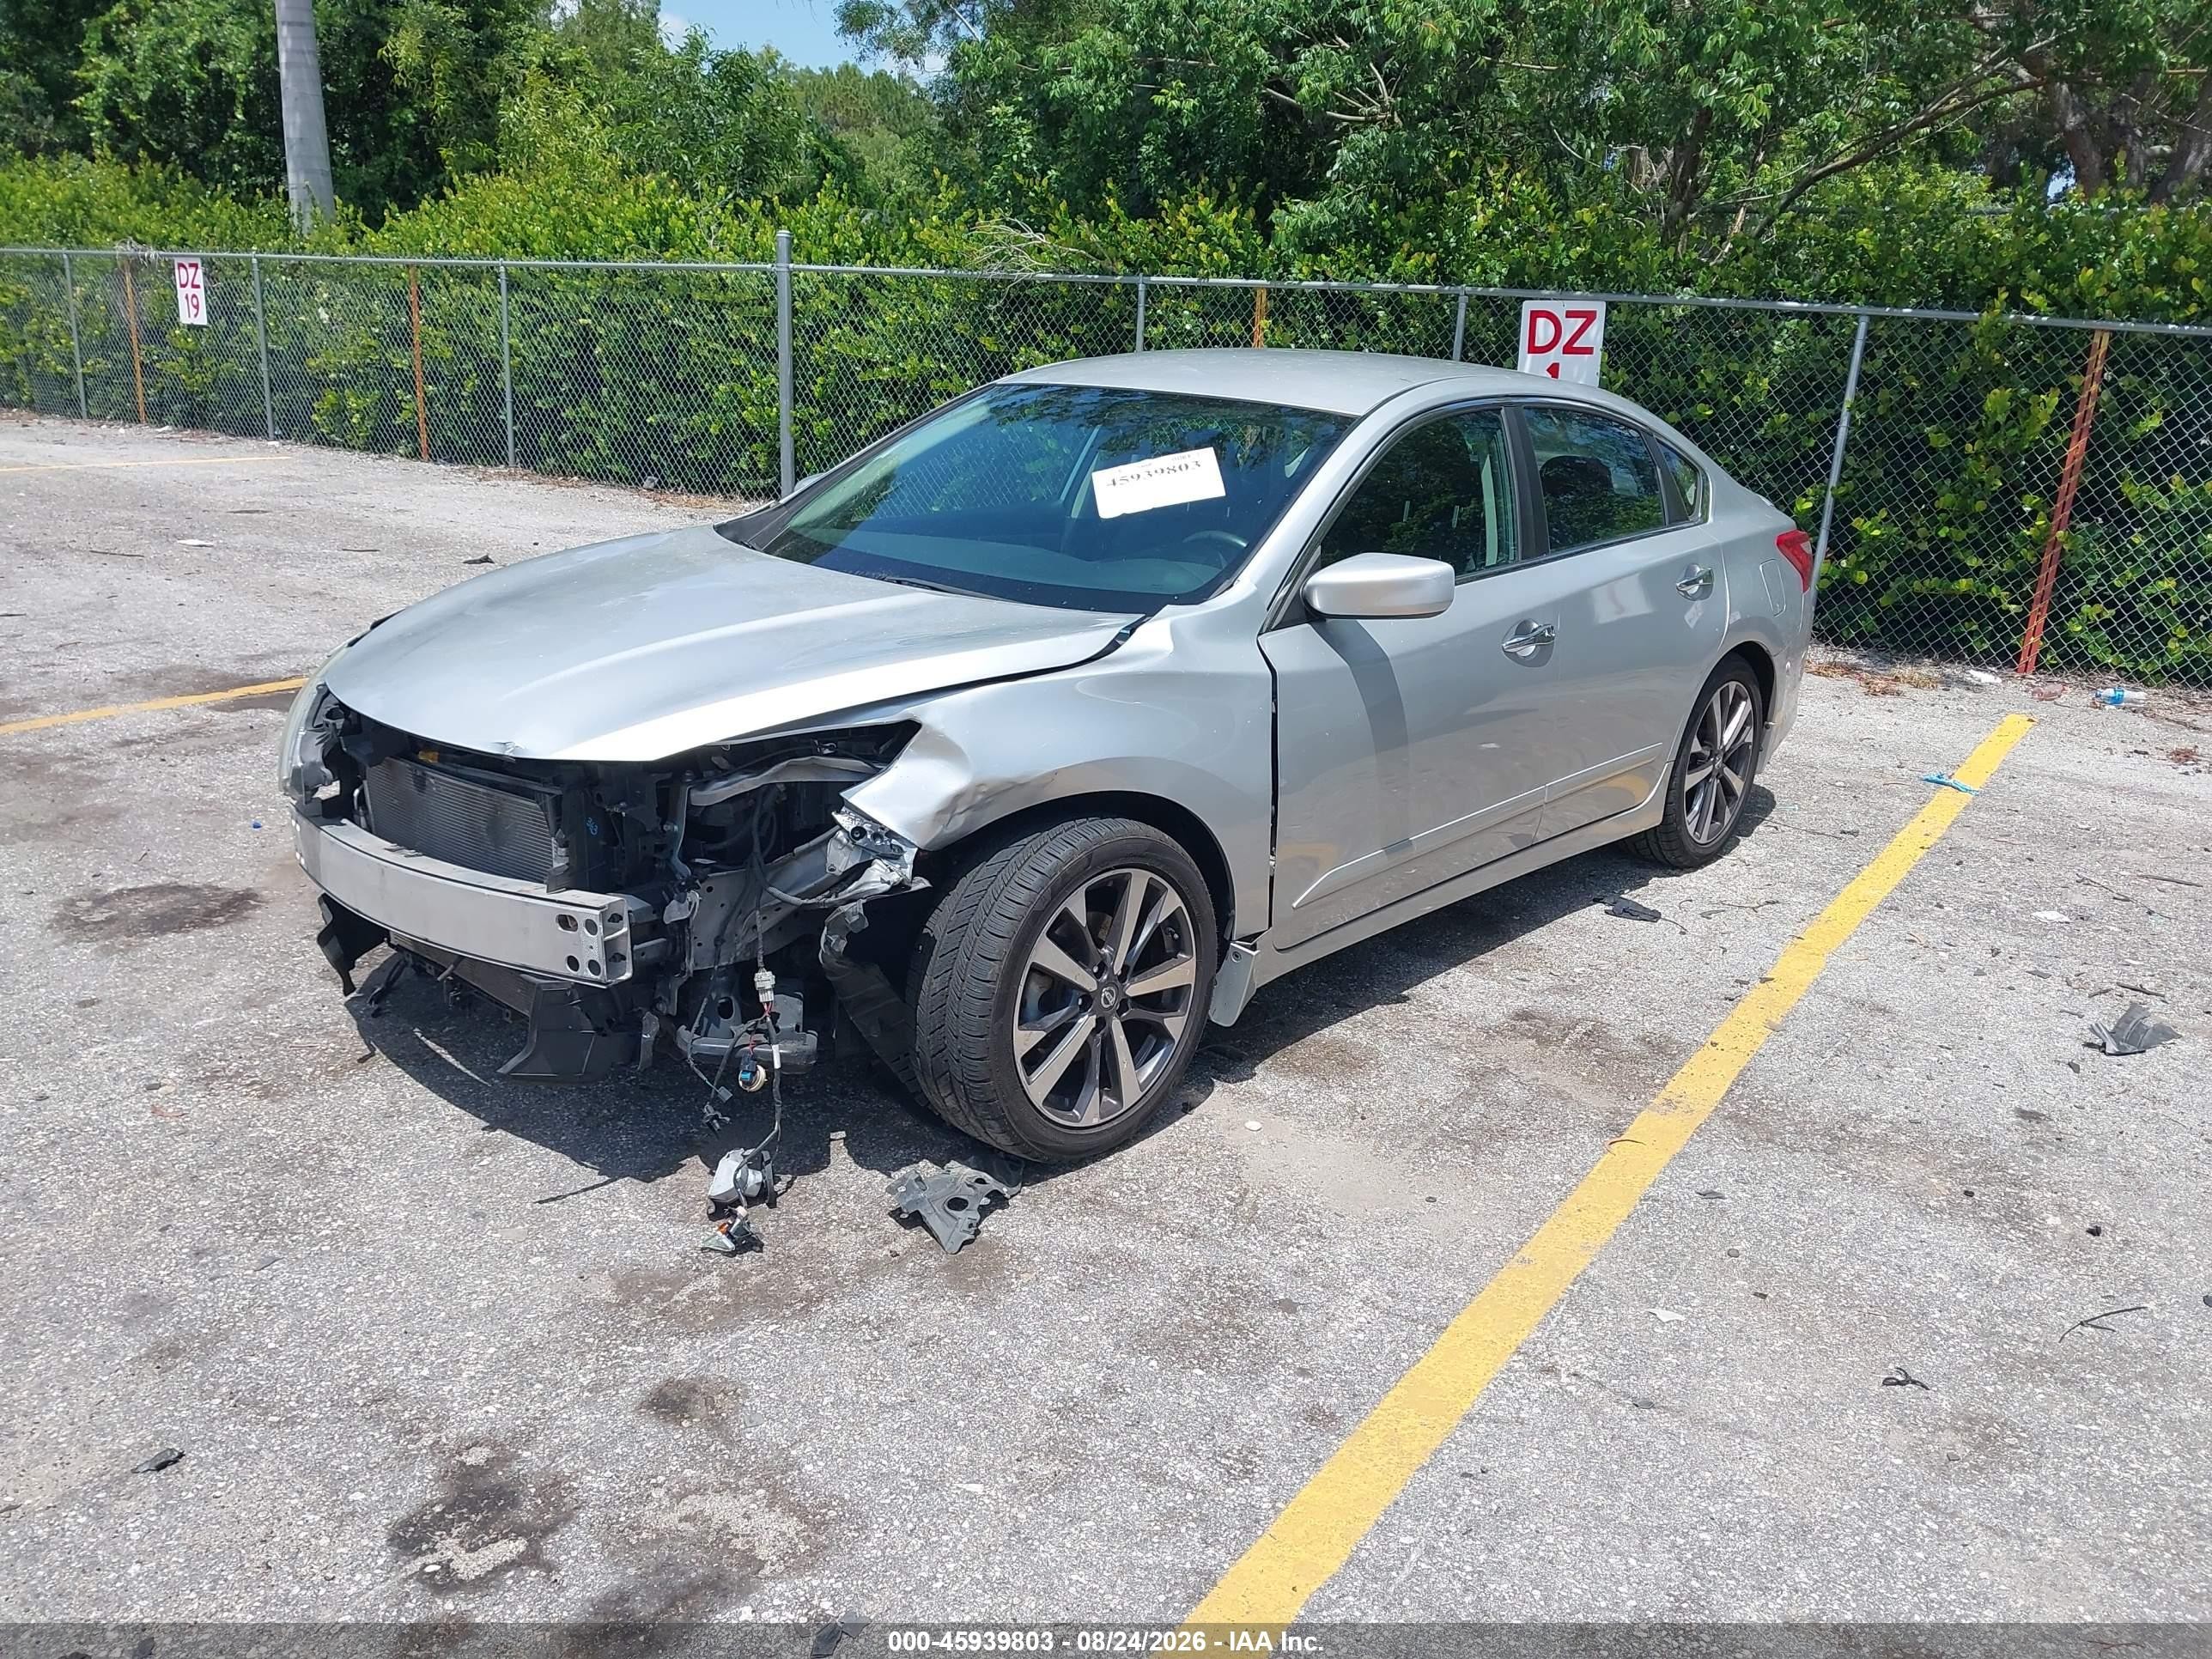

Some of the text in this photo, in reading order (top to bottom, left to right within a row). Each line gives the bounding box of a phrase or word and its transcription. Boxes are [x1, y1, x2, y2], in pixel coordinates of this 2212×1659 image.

[177, 262, 201, 289] DZ
[185, 293, 200, 319] 19
[1527, 309, 1597, 355] DZ
[1106, 459, 1202, 488] 45939803
